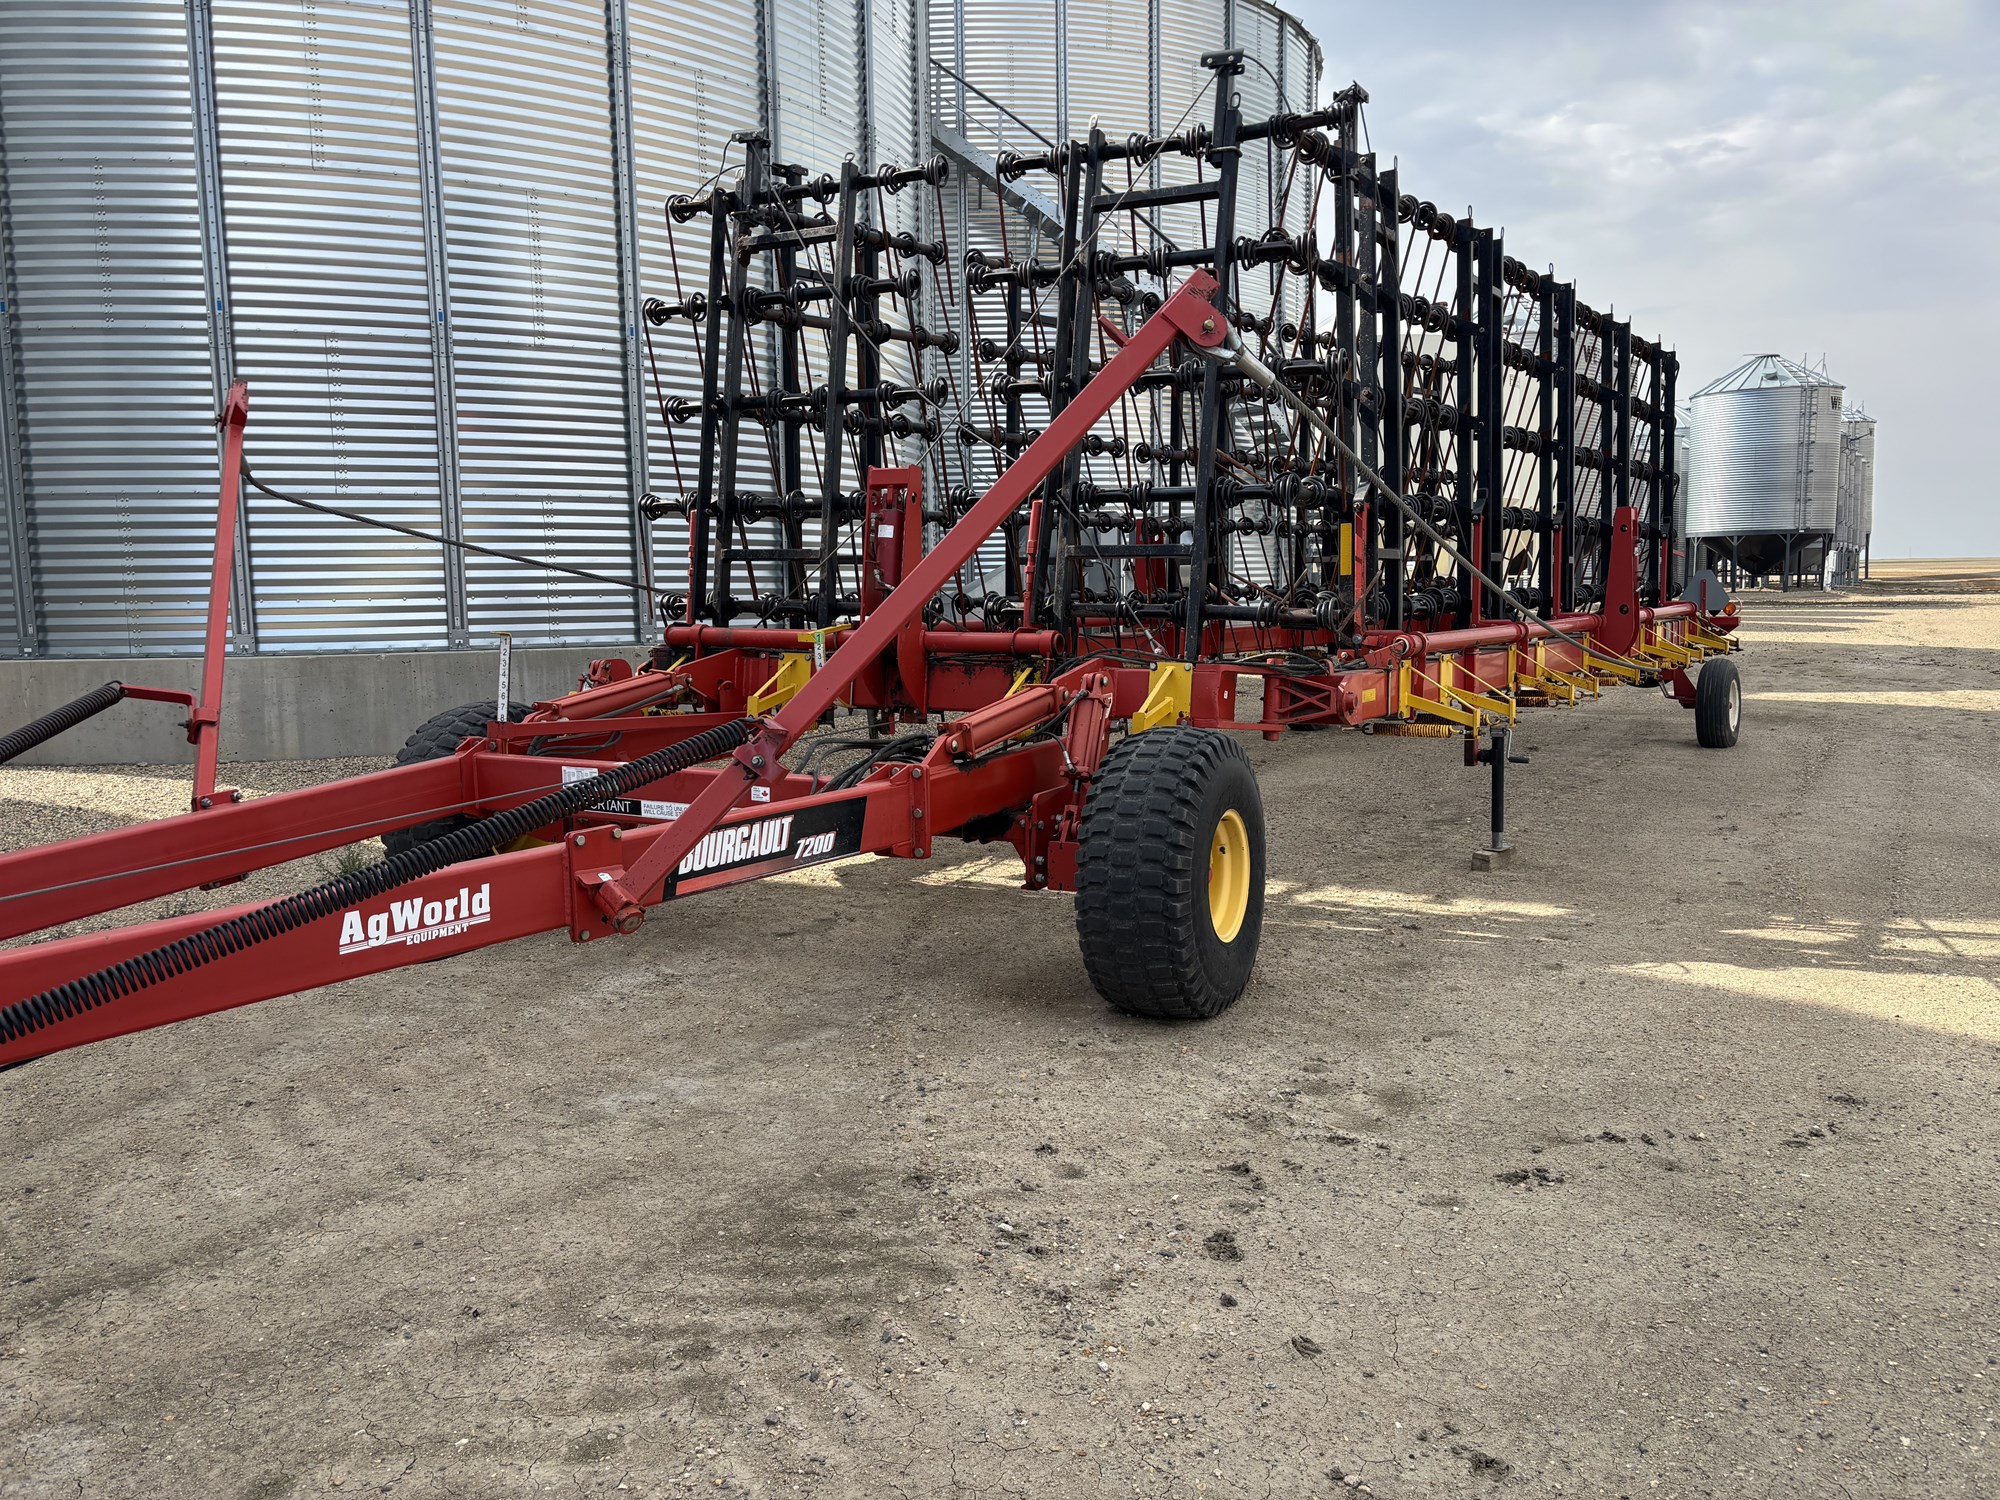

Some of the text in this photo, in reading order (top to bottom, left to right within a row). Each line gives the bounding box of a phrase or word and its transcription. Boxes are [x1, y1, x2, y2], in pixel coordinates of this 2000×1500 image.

[643, 803, 664, 811] FAILURE
[678, 815, 836, 875] BOURGAULT 7200
[339, 883, 491, 947] AgWorld
[406, 922, 470, 946] EQUIPMENT
